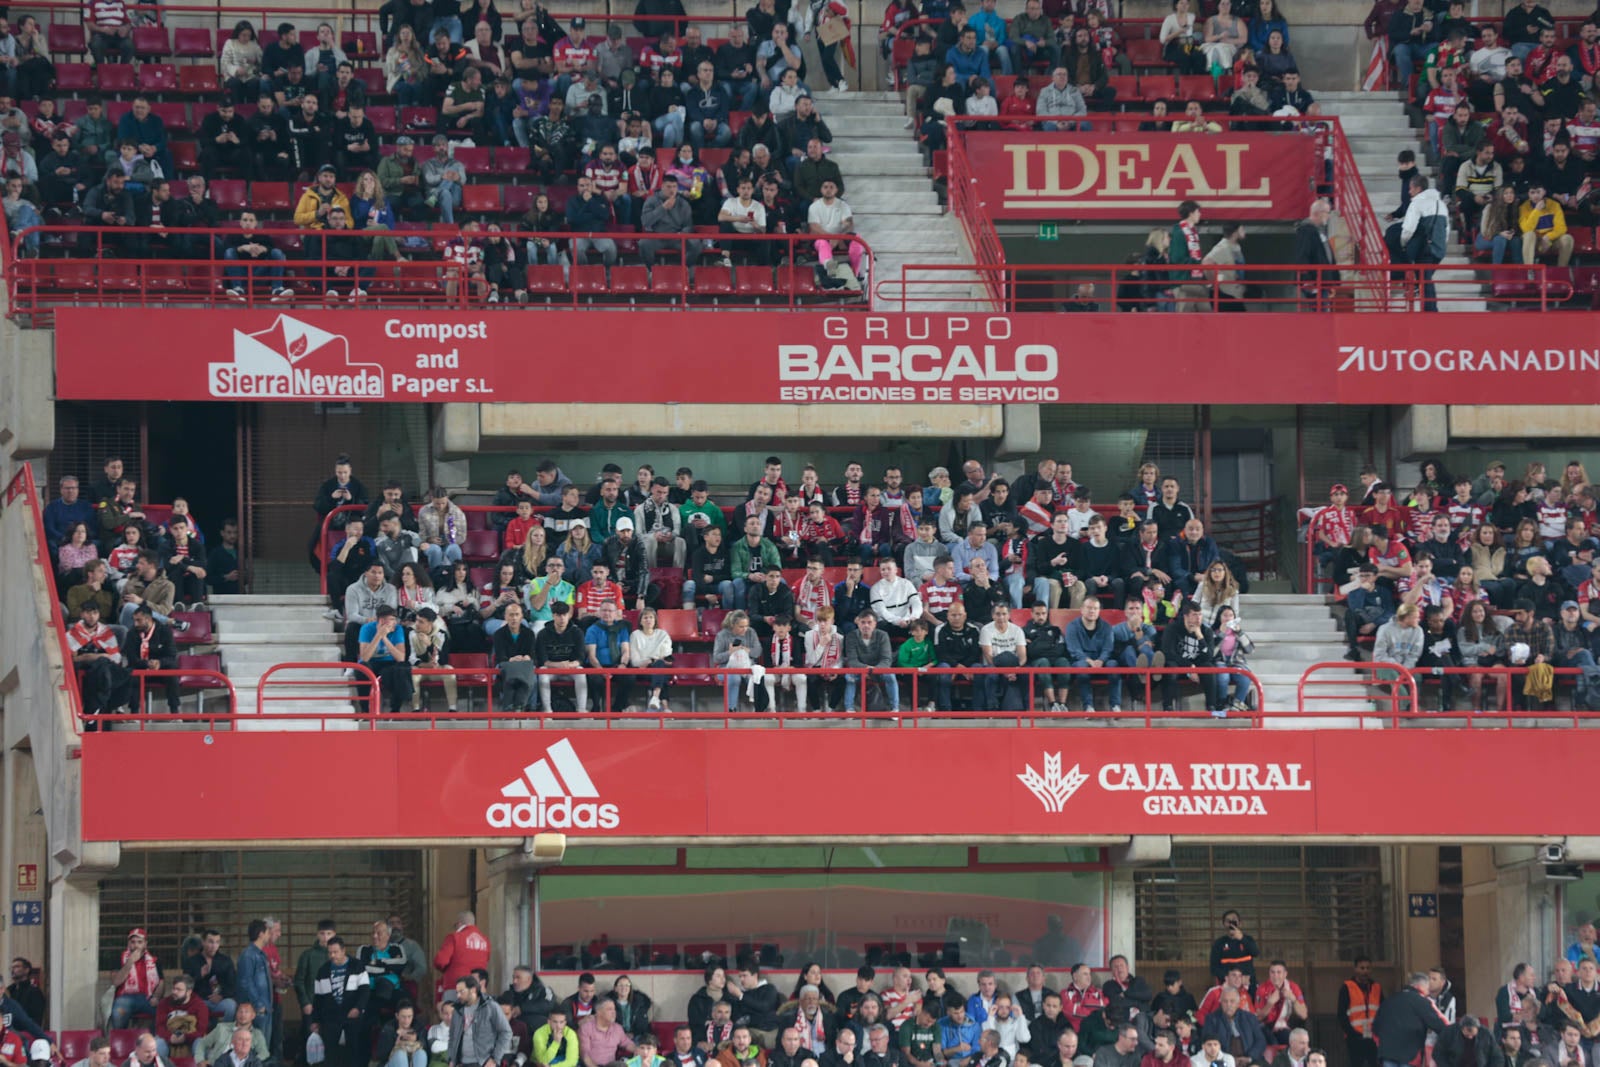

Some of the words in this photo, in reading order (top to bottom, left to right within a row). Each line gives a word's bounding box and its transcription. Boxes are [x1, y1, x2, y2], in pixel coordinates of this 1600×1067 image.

[1003, 143, 1271, 198] IDEAL
[384, 319, 488, 343] Compost
[823, 316, 1011, 340] GRUPO
[415, 349, 459, 369] and
[778, 344, 1059, 382] BARCALO
[391, 374, 460, 397] Paper
[465, 379, 494, 393] S.L.
[780, 386, 915, 401] ESTACIONES
[923, 386, 953, 401] DE
[959, 386, 1060, 401] SERVICIO
[1098, 763, 1184, 792] CAJA
[1189, 763, 1312, 791] RURAL
[486, 794, 620, 829] adidas
[1142, 795, 1268, 816] GRANADA
